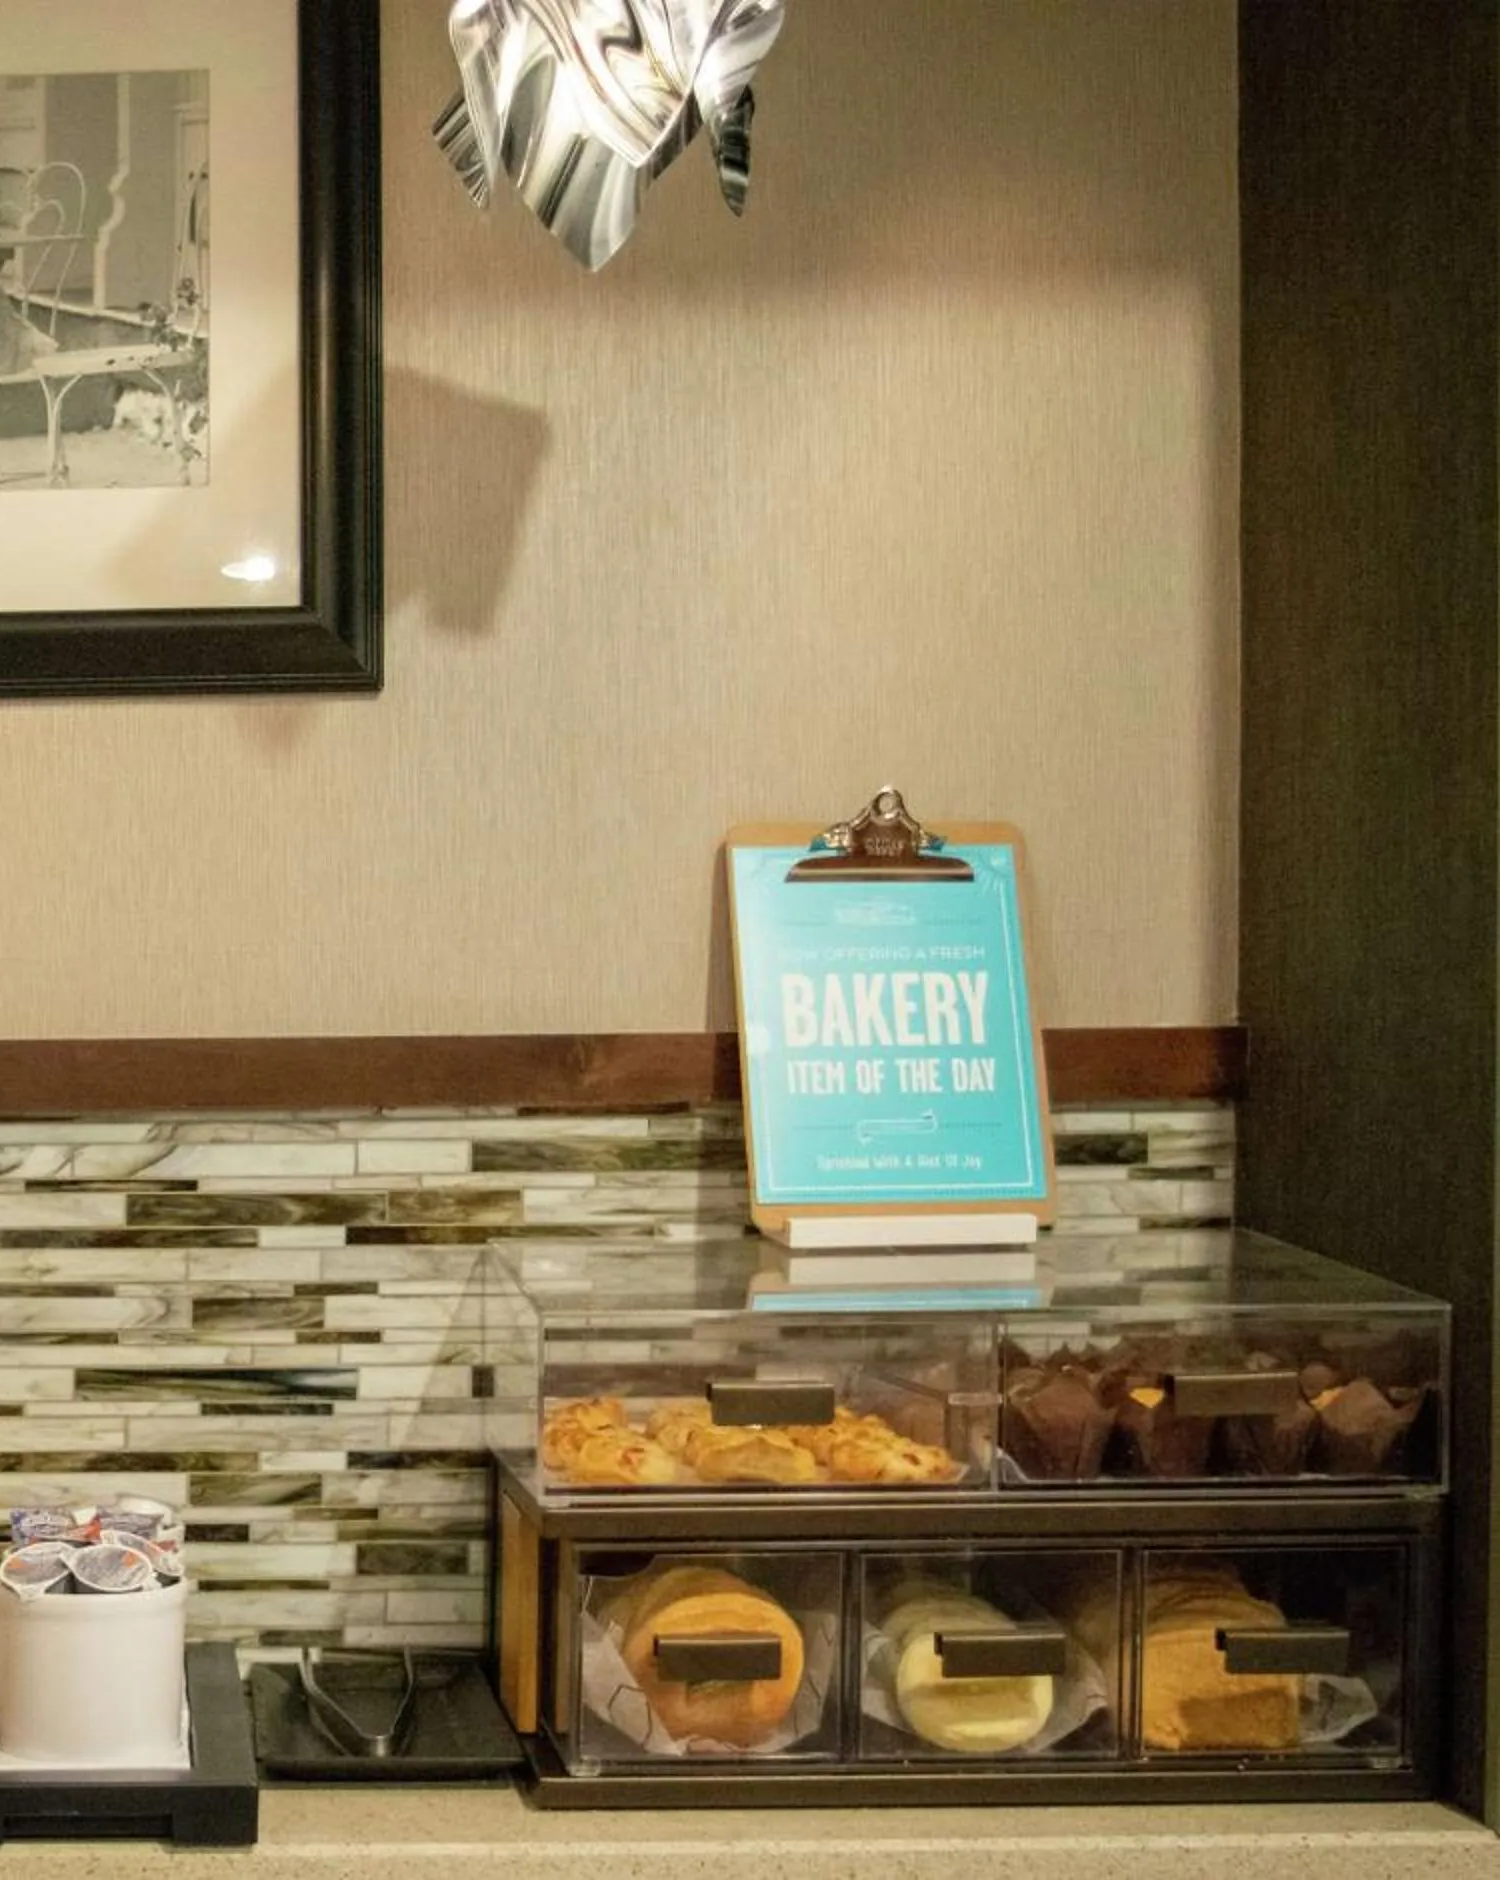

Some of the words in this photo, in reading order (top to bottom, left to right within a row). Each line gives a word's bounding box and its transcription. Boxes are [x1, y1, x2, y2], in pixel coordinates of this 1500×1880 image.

[780, 970, 989, 1048] BAKERY
[787, 1060, 845, 1095] ITEM
[855, 1059, 885, 1094] OF
[895, 1058, 942, 1093] THE
[951, 1057, 996, 1092] DAY
